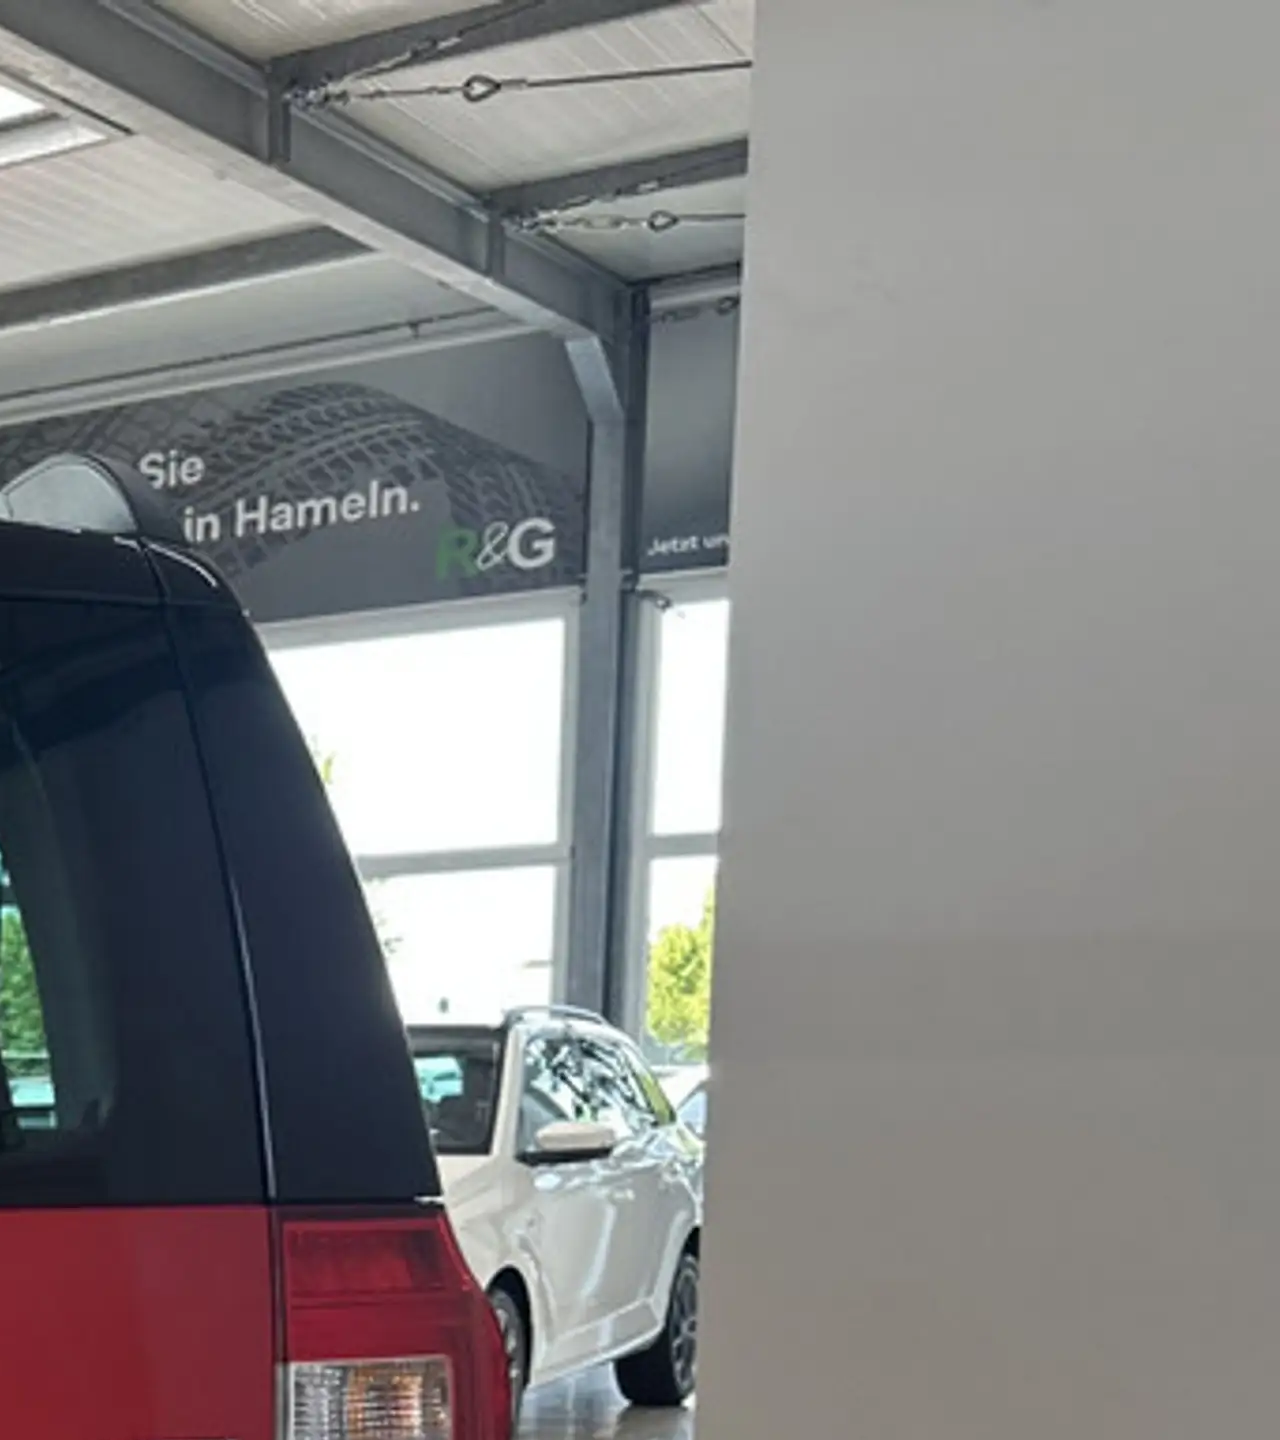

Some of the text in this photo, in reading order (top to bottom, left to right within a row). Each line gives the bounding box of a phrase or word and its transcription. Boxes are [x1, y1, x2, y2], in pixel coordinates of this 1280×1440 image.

[139, 450, 205, 490] Sie
[183, 480, 420, 543] in Hameln.
[438, 517, 556, 579] R&G
